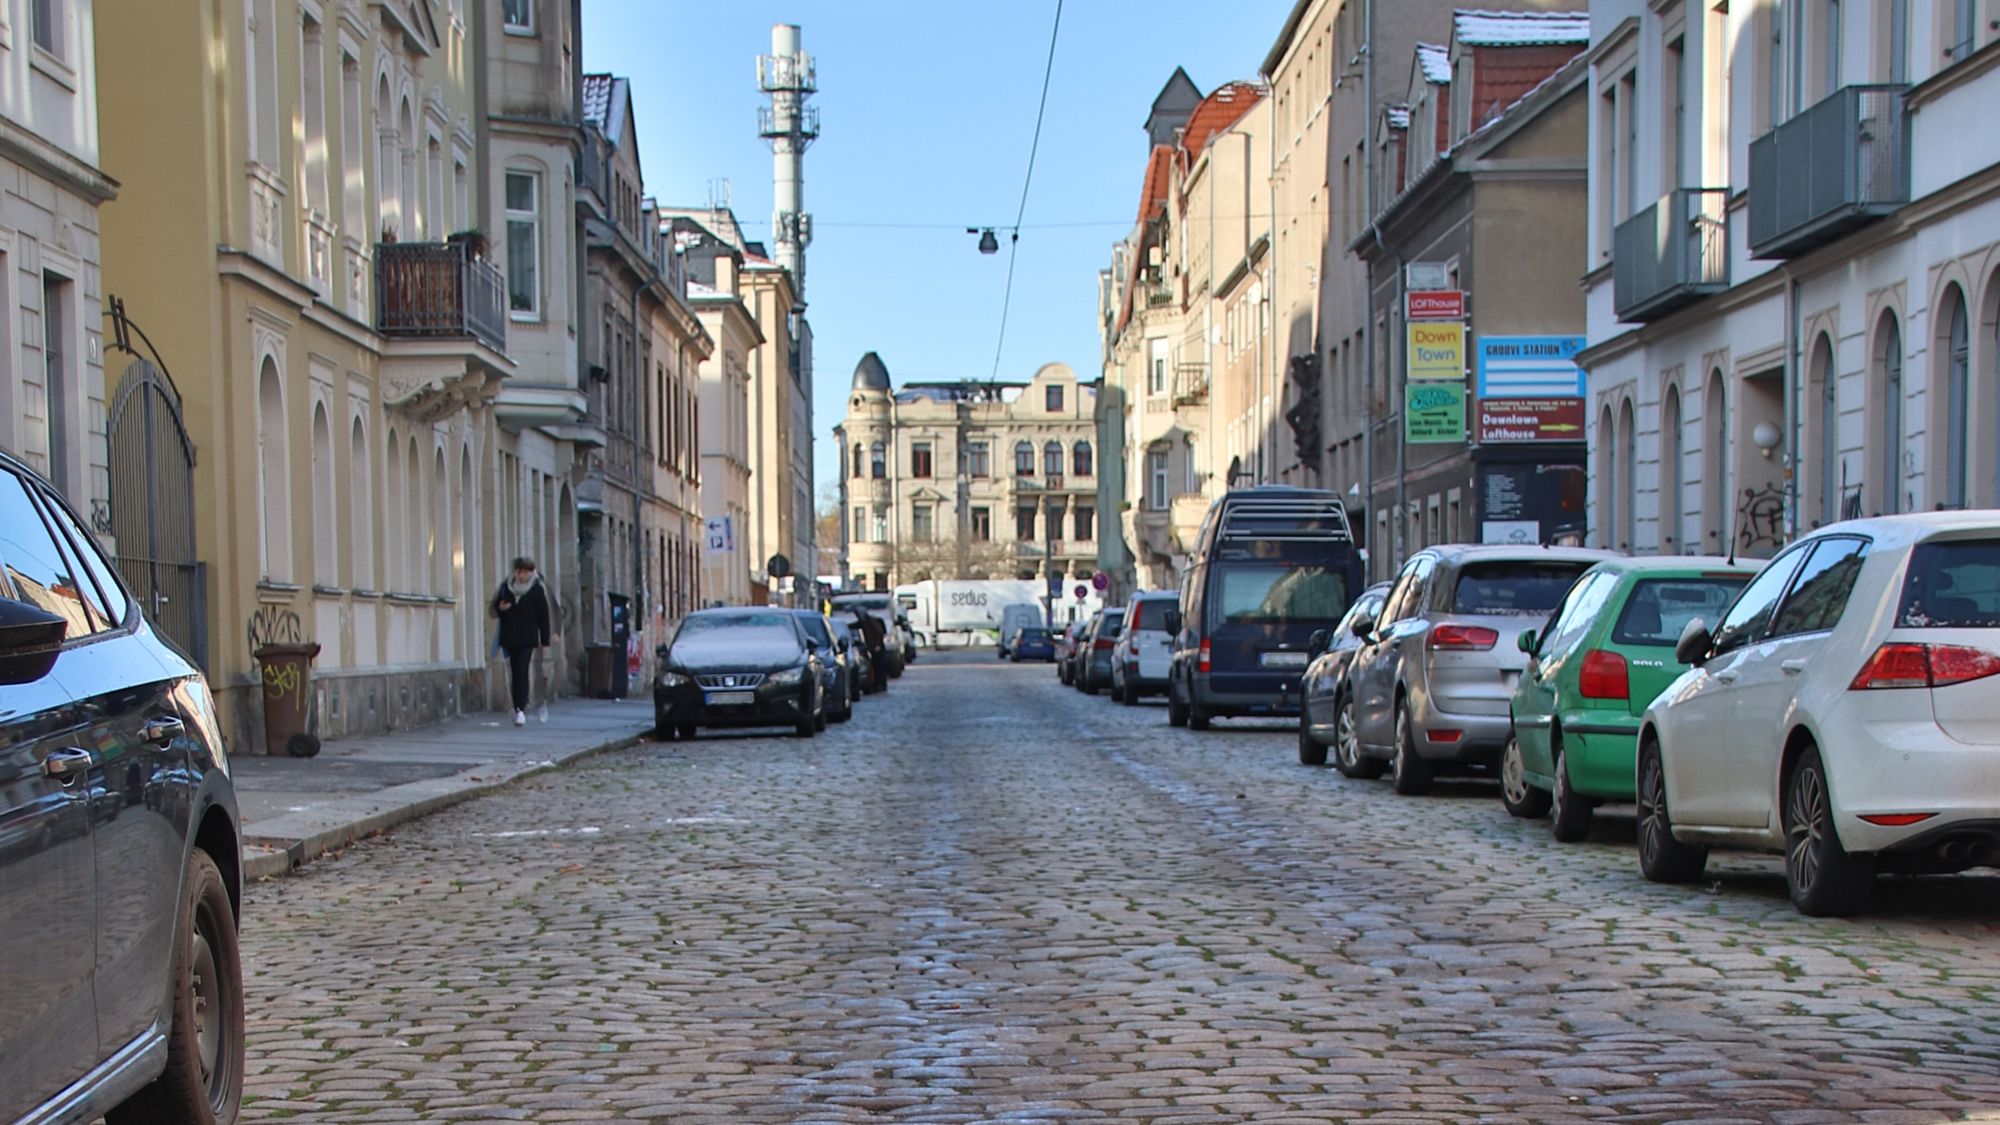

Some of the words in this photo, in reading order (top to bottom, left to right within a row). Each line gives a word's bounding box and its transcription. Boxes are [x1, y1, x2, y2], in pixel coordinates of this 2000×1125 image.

[1415, 330, 1456, 343] Down
[1416, 347, 1456, 361] Town
[1486, 344, 1520, 355] GROOVE
[1523, 344, 1560, 355] STATION
[1482, 414, 1538, 425] Downtown
[1482, 428, 1535, 439] Lofthouse
[951, 590, 988, 605] sedus
